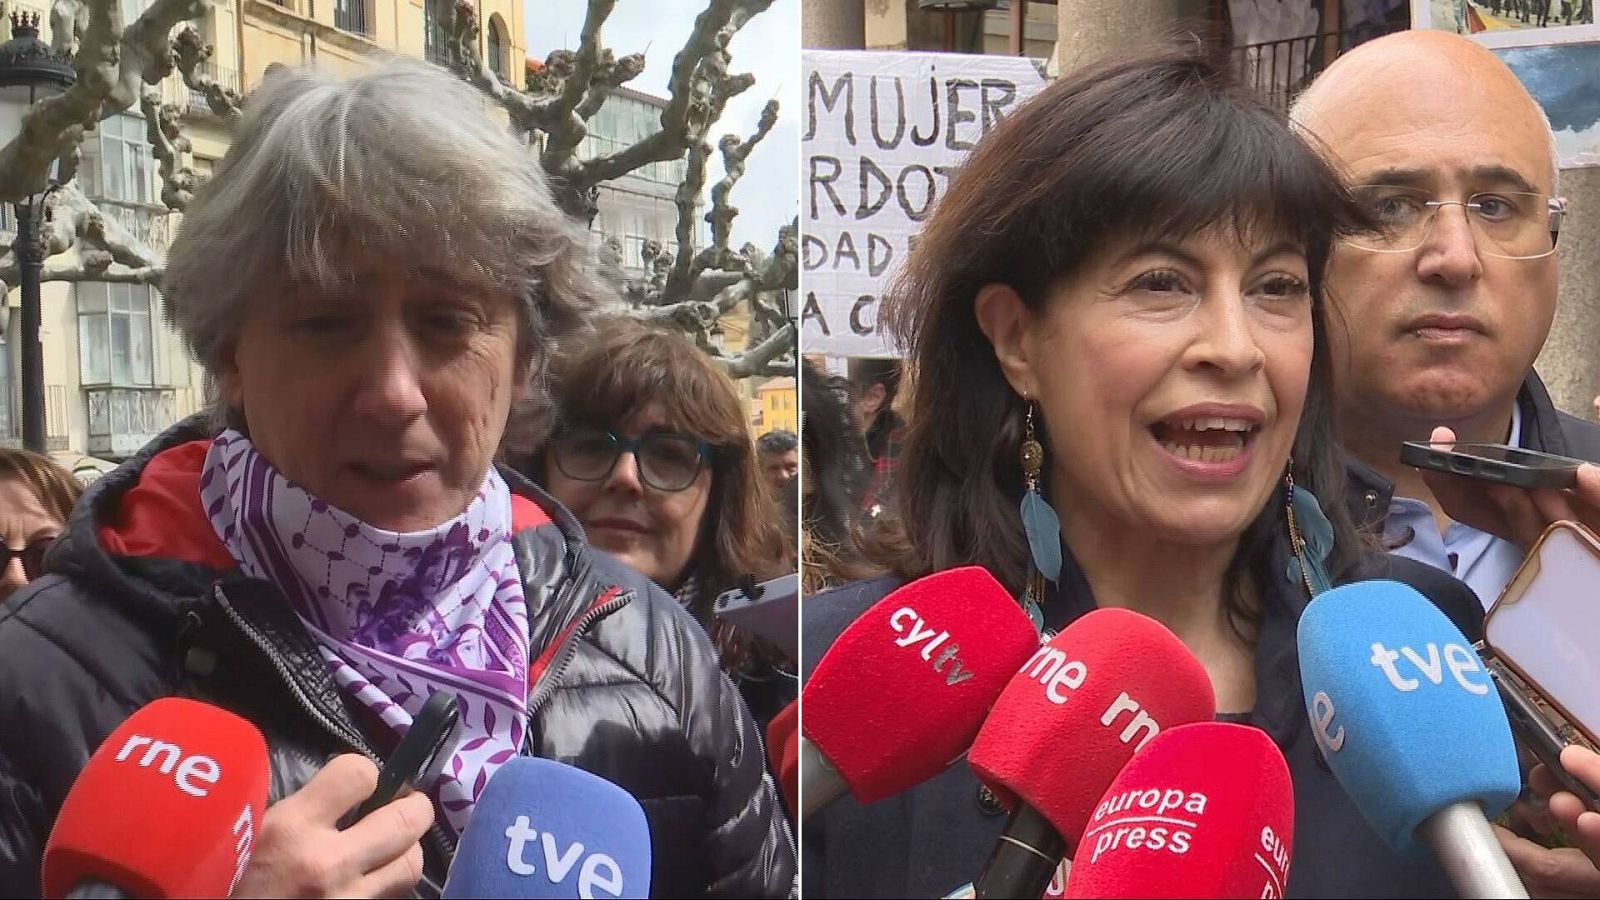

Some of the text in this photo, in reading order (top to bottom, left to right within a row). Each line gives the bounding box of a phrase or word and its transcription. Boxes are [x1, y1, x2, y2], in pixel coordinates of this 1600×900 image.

[803, 65, 1016, 151] MUJER
[850, 294, 886, 336] C
[890, 606, 975, 686] cyltv
[1018, 645, 1088, 704] rne
[1370, 642, 1489, 695] tve
[1100, 691, 1160, 754] rn
[115, 734, 221, 797] rne
[1094, 788, 1208, 821] europa
[505, 815, 624, 899] tve
[1090, 827, 1193, 864] press
[1261, 826, 1291, 887] eur
